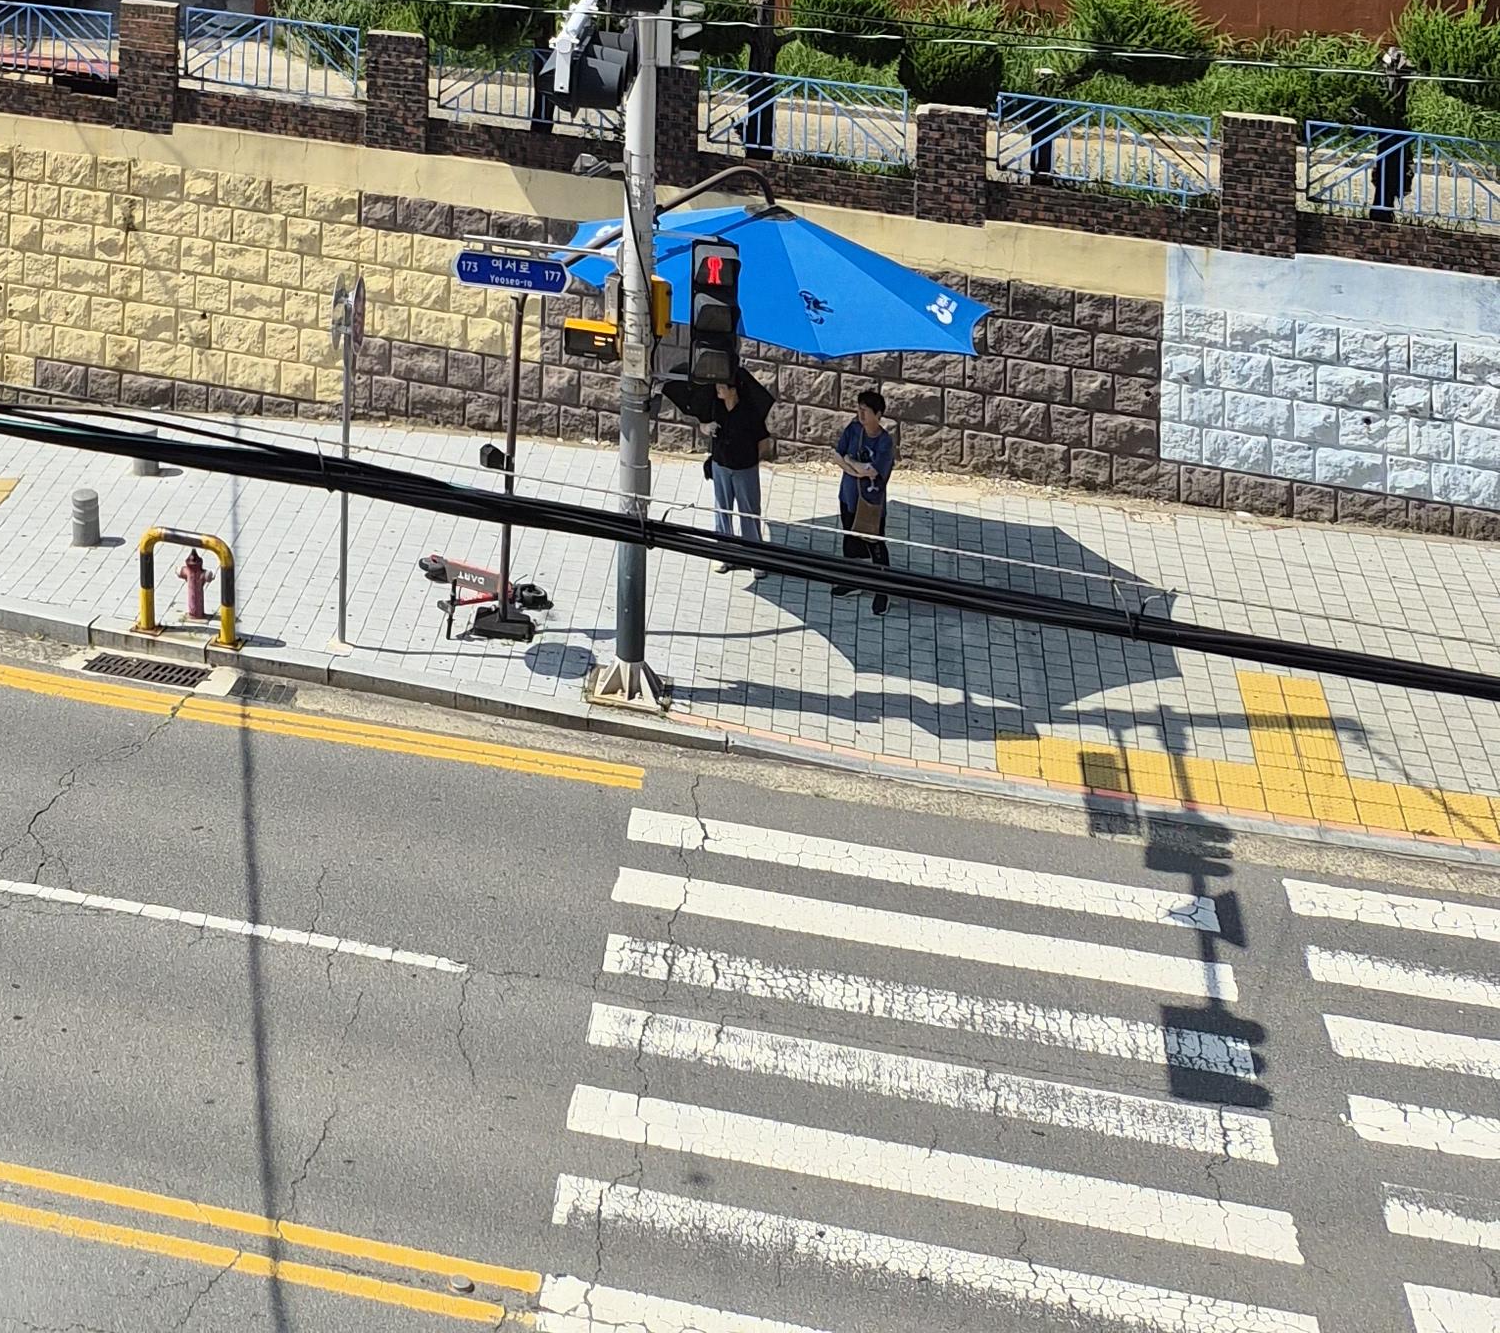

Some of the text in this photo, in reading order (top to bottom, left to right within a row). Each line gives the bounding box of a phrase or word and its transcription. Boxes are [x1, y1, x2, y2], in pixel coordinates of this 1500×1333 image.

[461, 258, 562, 283] 173 여서로 177
[490, 274, 533, 288] Yeoseo-ro
[457, 570, 484, 587] DART
